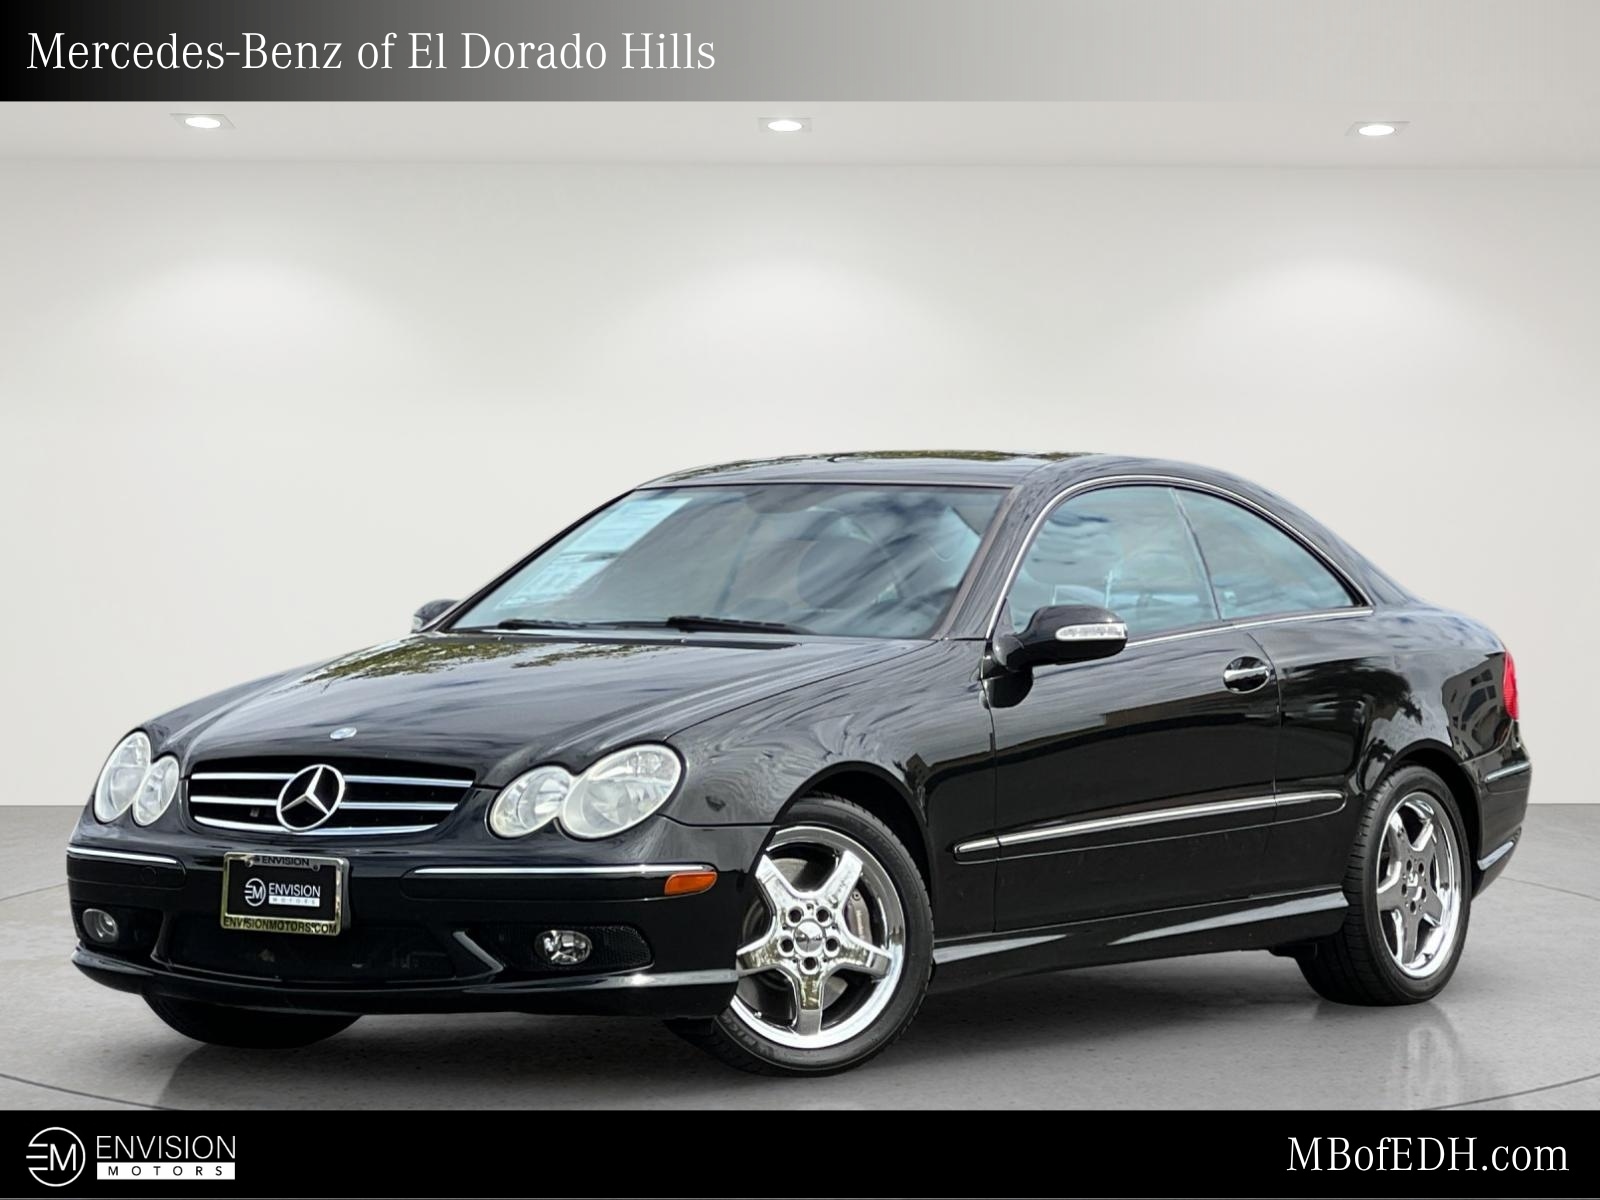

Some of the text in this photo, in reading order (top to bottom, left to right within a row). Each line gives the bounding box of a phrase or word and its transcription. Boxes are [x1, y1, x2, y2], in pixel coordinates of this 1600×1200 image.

[262, 856, 310, 867] ENVISION
[268, 883, 321, 898] ENVISION
[223, 917, 337, 934] ENVISIONMOTORS.COM
